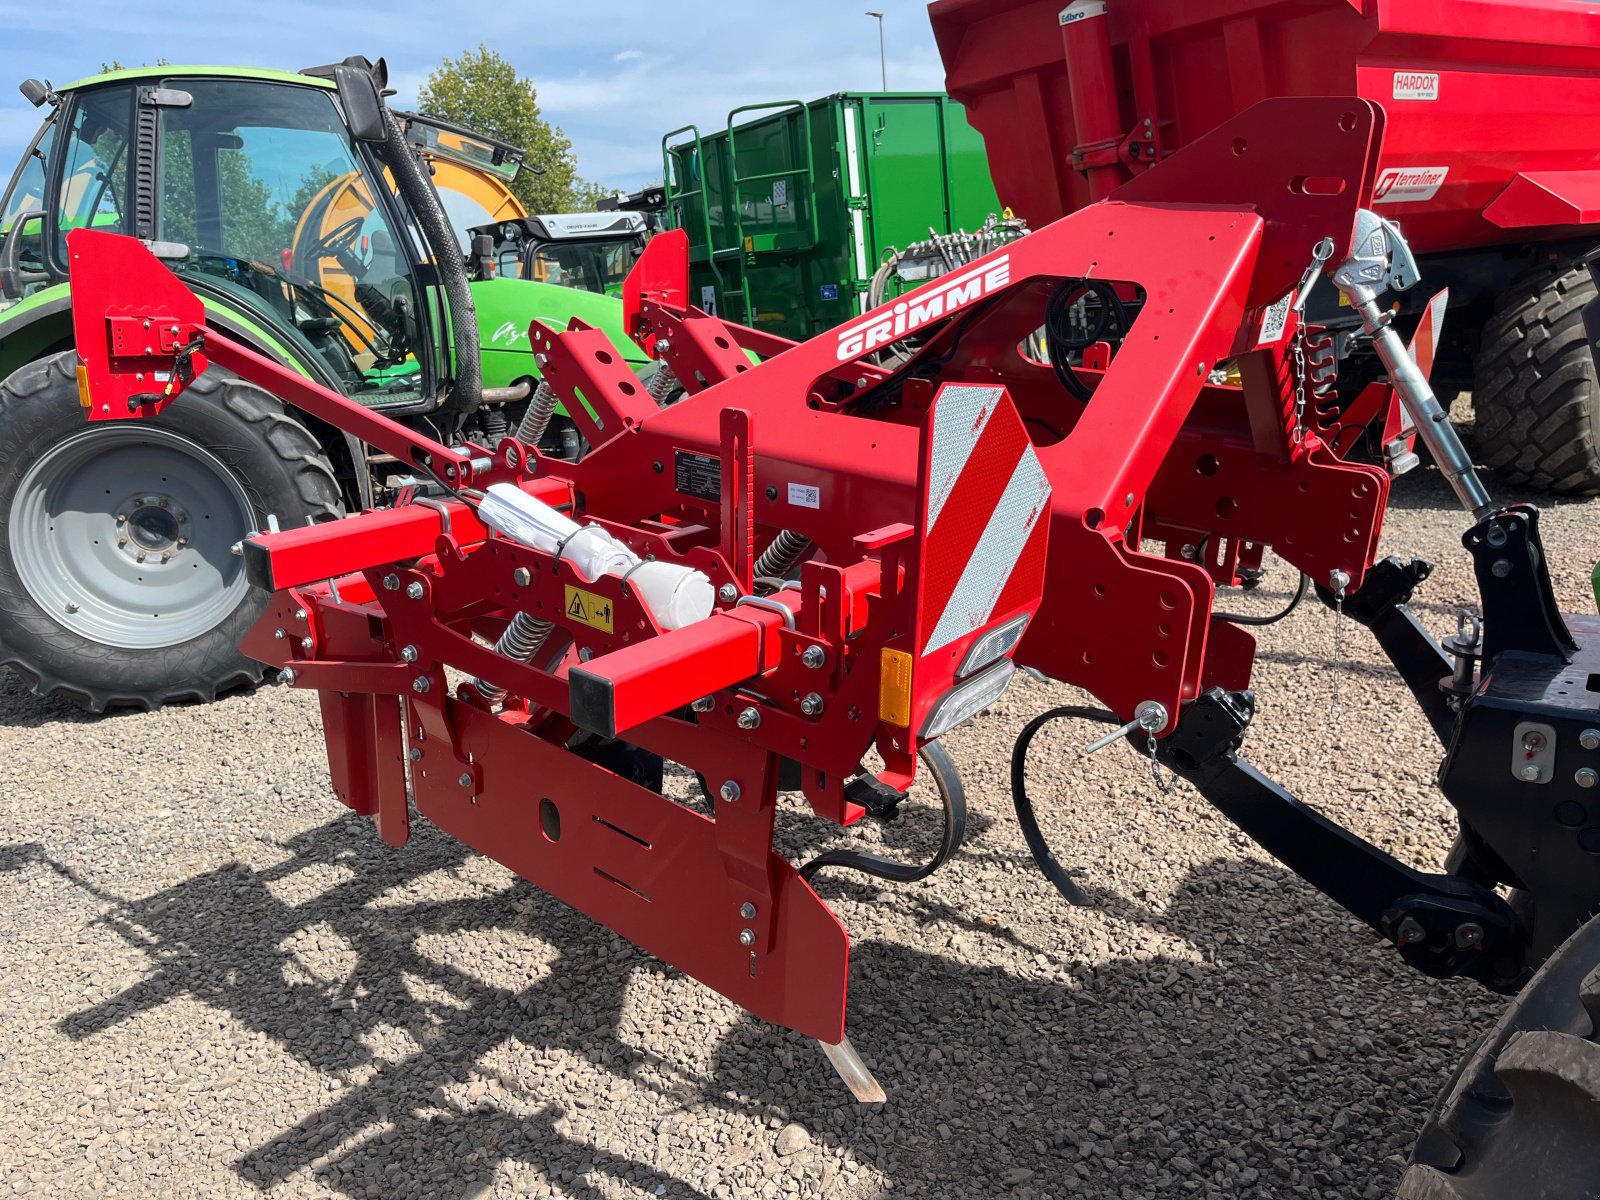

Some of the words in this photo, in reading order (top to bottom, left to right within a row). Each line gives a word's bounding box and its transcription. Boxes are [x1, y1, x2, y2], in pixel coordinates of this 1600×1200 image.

[1061, 11, 1085, 23] Edbro
[1395, 75, 1436, 90] HARDOX
[1395, 169, 1442, 186] terraliner
